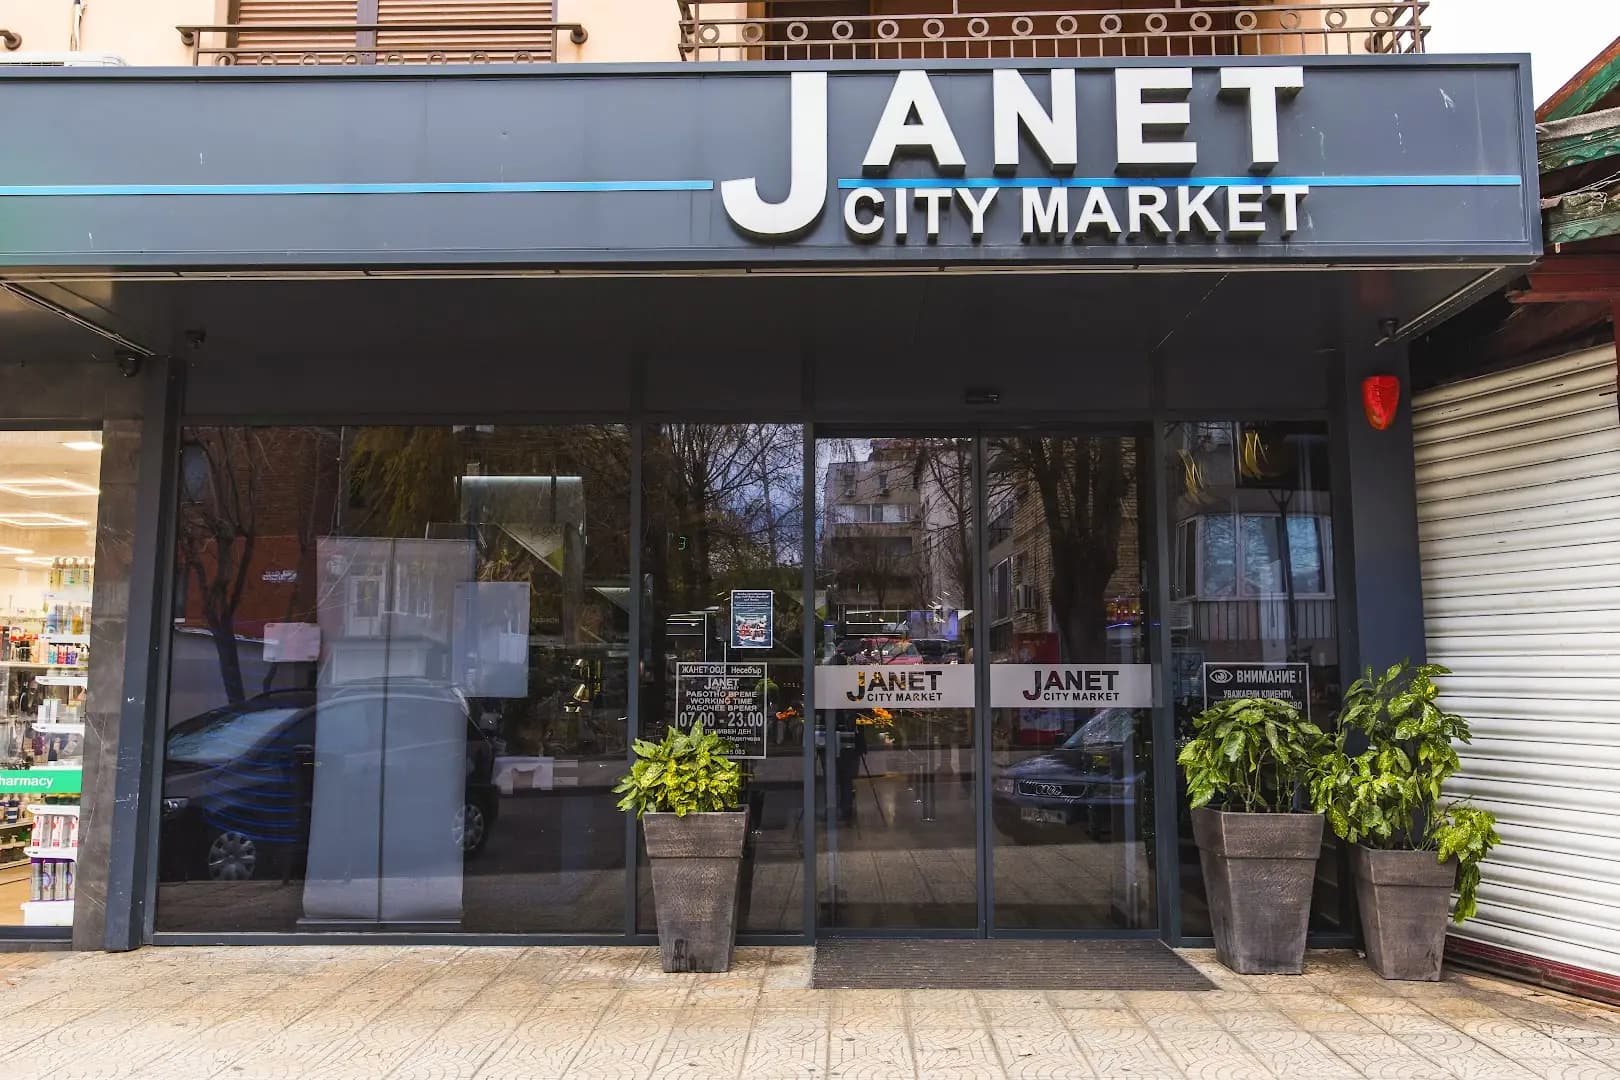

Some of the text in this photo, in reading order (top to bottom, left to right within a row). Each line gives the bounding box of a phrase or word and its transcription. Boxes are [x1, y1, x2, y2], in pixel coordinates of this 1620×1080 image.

[721, 68, 1304, 236] JANET
[843, 184, 1310, 240] CITY MARKET
[682, 666, 762, 676] ЖАНЕТ ООД Несебър
[1236, 670, 1296, 683] ВНИМАНИЕ
[704, 678, 740, 690] JANET
[846, 671, 943, 702] JANET
[1022, 670, 1120, 701] JANET
[686, 690, 726, 698] РАБОТНО
[867, 692, 943, 702] CITY MARKET
[1043, 692, 1120, 701] CITY MARKET
[1223, 689, 1294, 700] УВАЖАЕМИ КЛИЕНТИ,
[680, 711, 715, 727] 0700
[727, 711, 763, 727] 23.00
